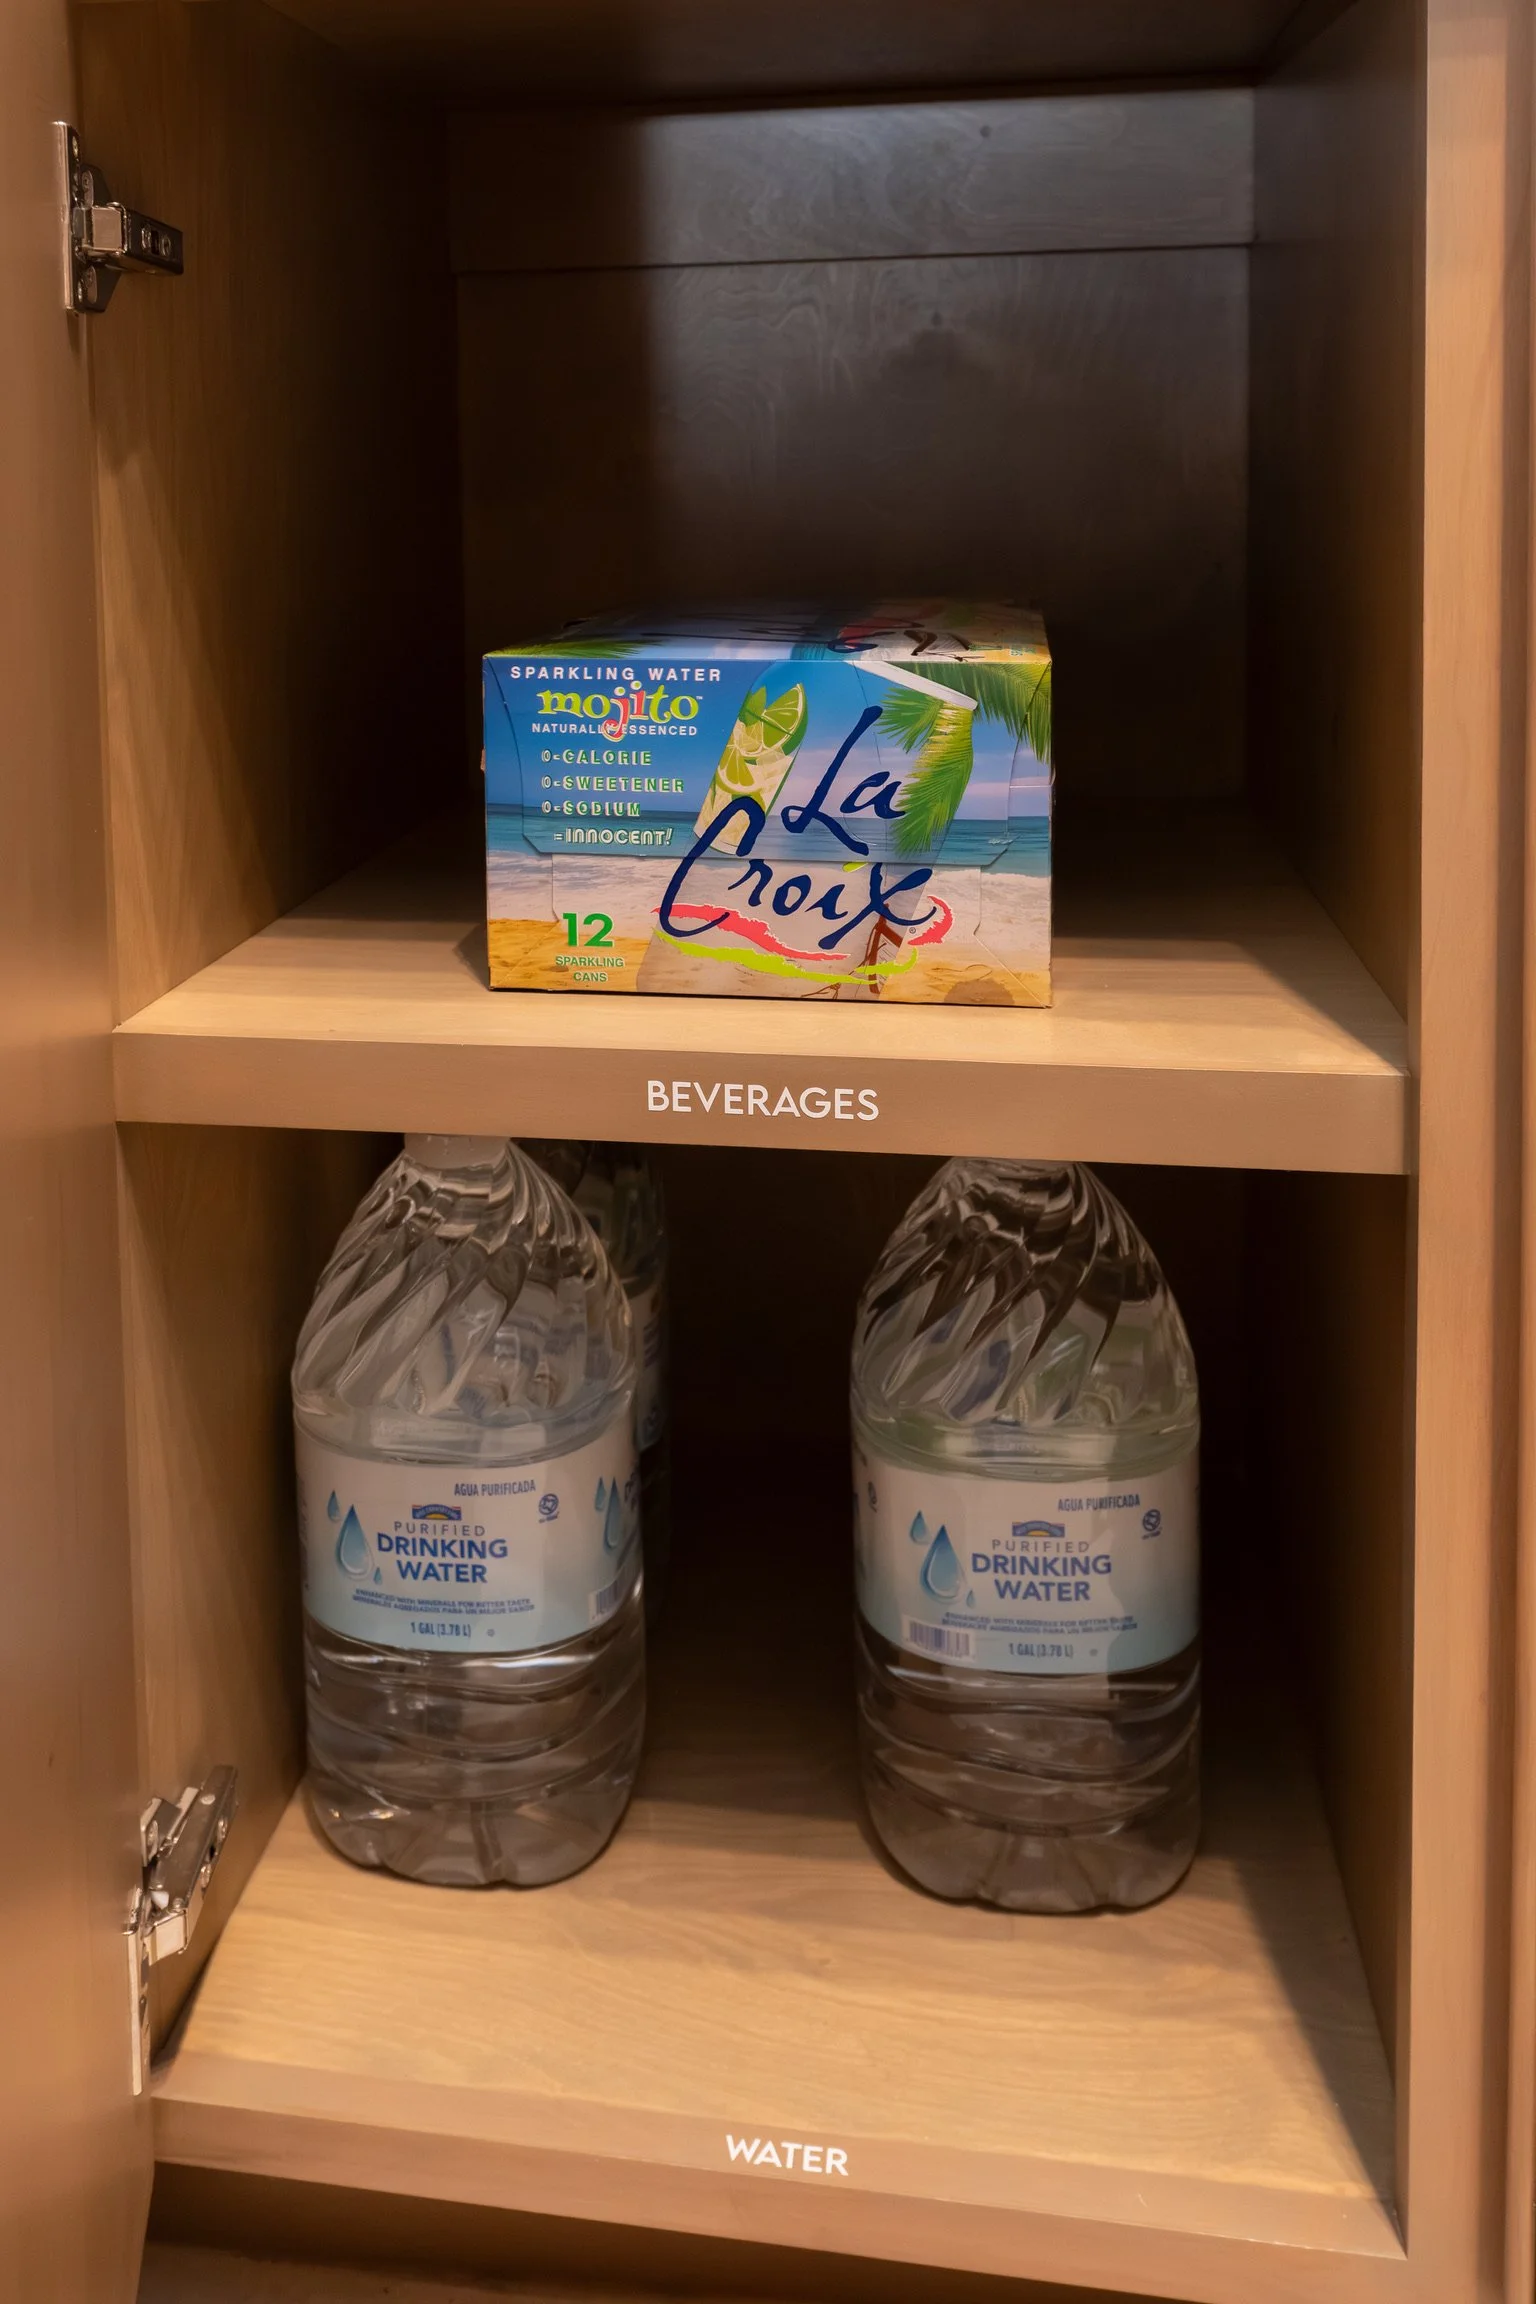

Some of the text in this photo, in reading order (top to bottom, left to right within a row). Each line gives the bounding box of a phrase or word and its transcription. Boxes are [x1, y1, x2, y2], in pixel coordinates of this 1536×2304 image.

[510, 666, 721, 682] SPARKLING WATER
[536, 680, 699, 743] mojito
[532, 722, 698, 736] NATURALLY ESSENCED
[781, 705, 907, 856] La
[659, 795, 938, 951] Croix
[562, 912, 615, 948] 12
[555, 955, 625, 968] SPARKLING
[573, 971, 608, 982] CANS
[647, 1080, 880, 1121] BEVERAGES
[454, 1479, 536, 1497] AGUA PURIFICADA
[1058, 1494, 1141, 1512] AGUA PURIFICADA
[394, 1520, 486, 1537] PURIFIED
[377, 1533, 509, 1559] DRINKING
[992, 1539, 1090, 1554] PURIFIED
[396, 1560, 488, 1584] WATER
[971, 1553, 1113, 1576] DRINKING
[994, 1579, 1091, 1602] WATER
[411, 1622, 472, 1638] 1 GAL (3.78 L)
[1008, 1643, 1014, 1655] 1
[1017, 1643, 1035, 1657] GAL
[1063, 1645, 1074, 1658] L)
[725, 2134, 849, 2176] WATER
